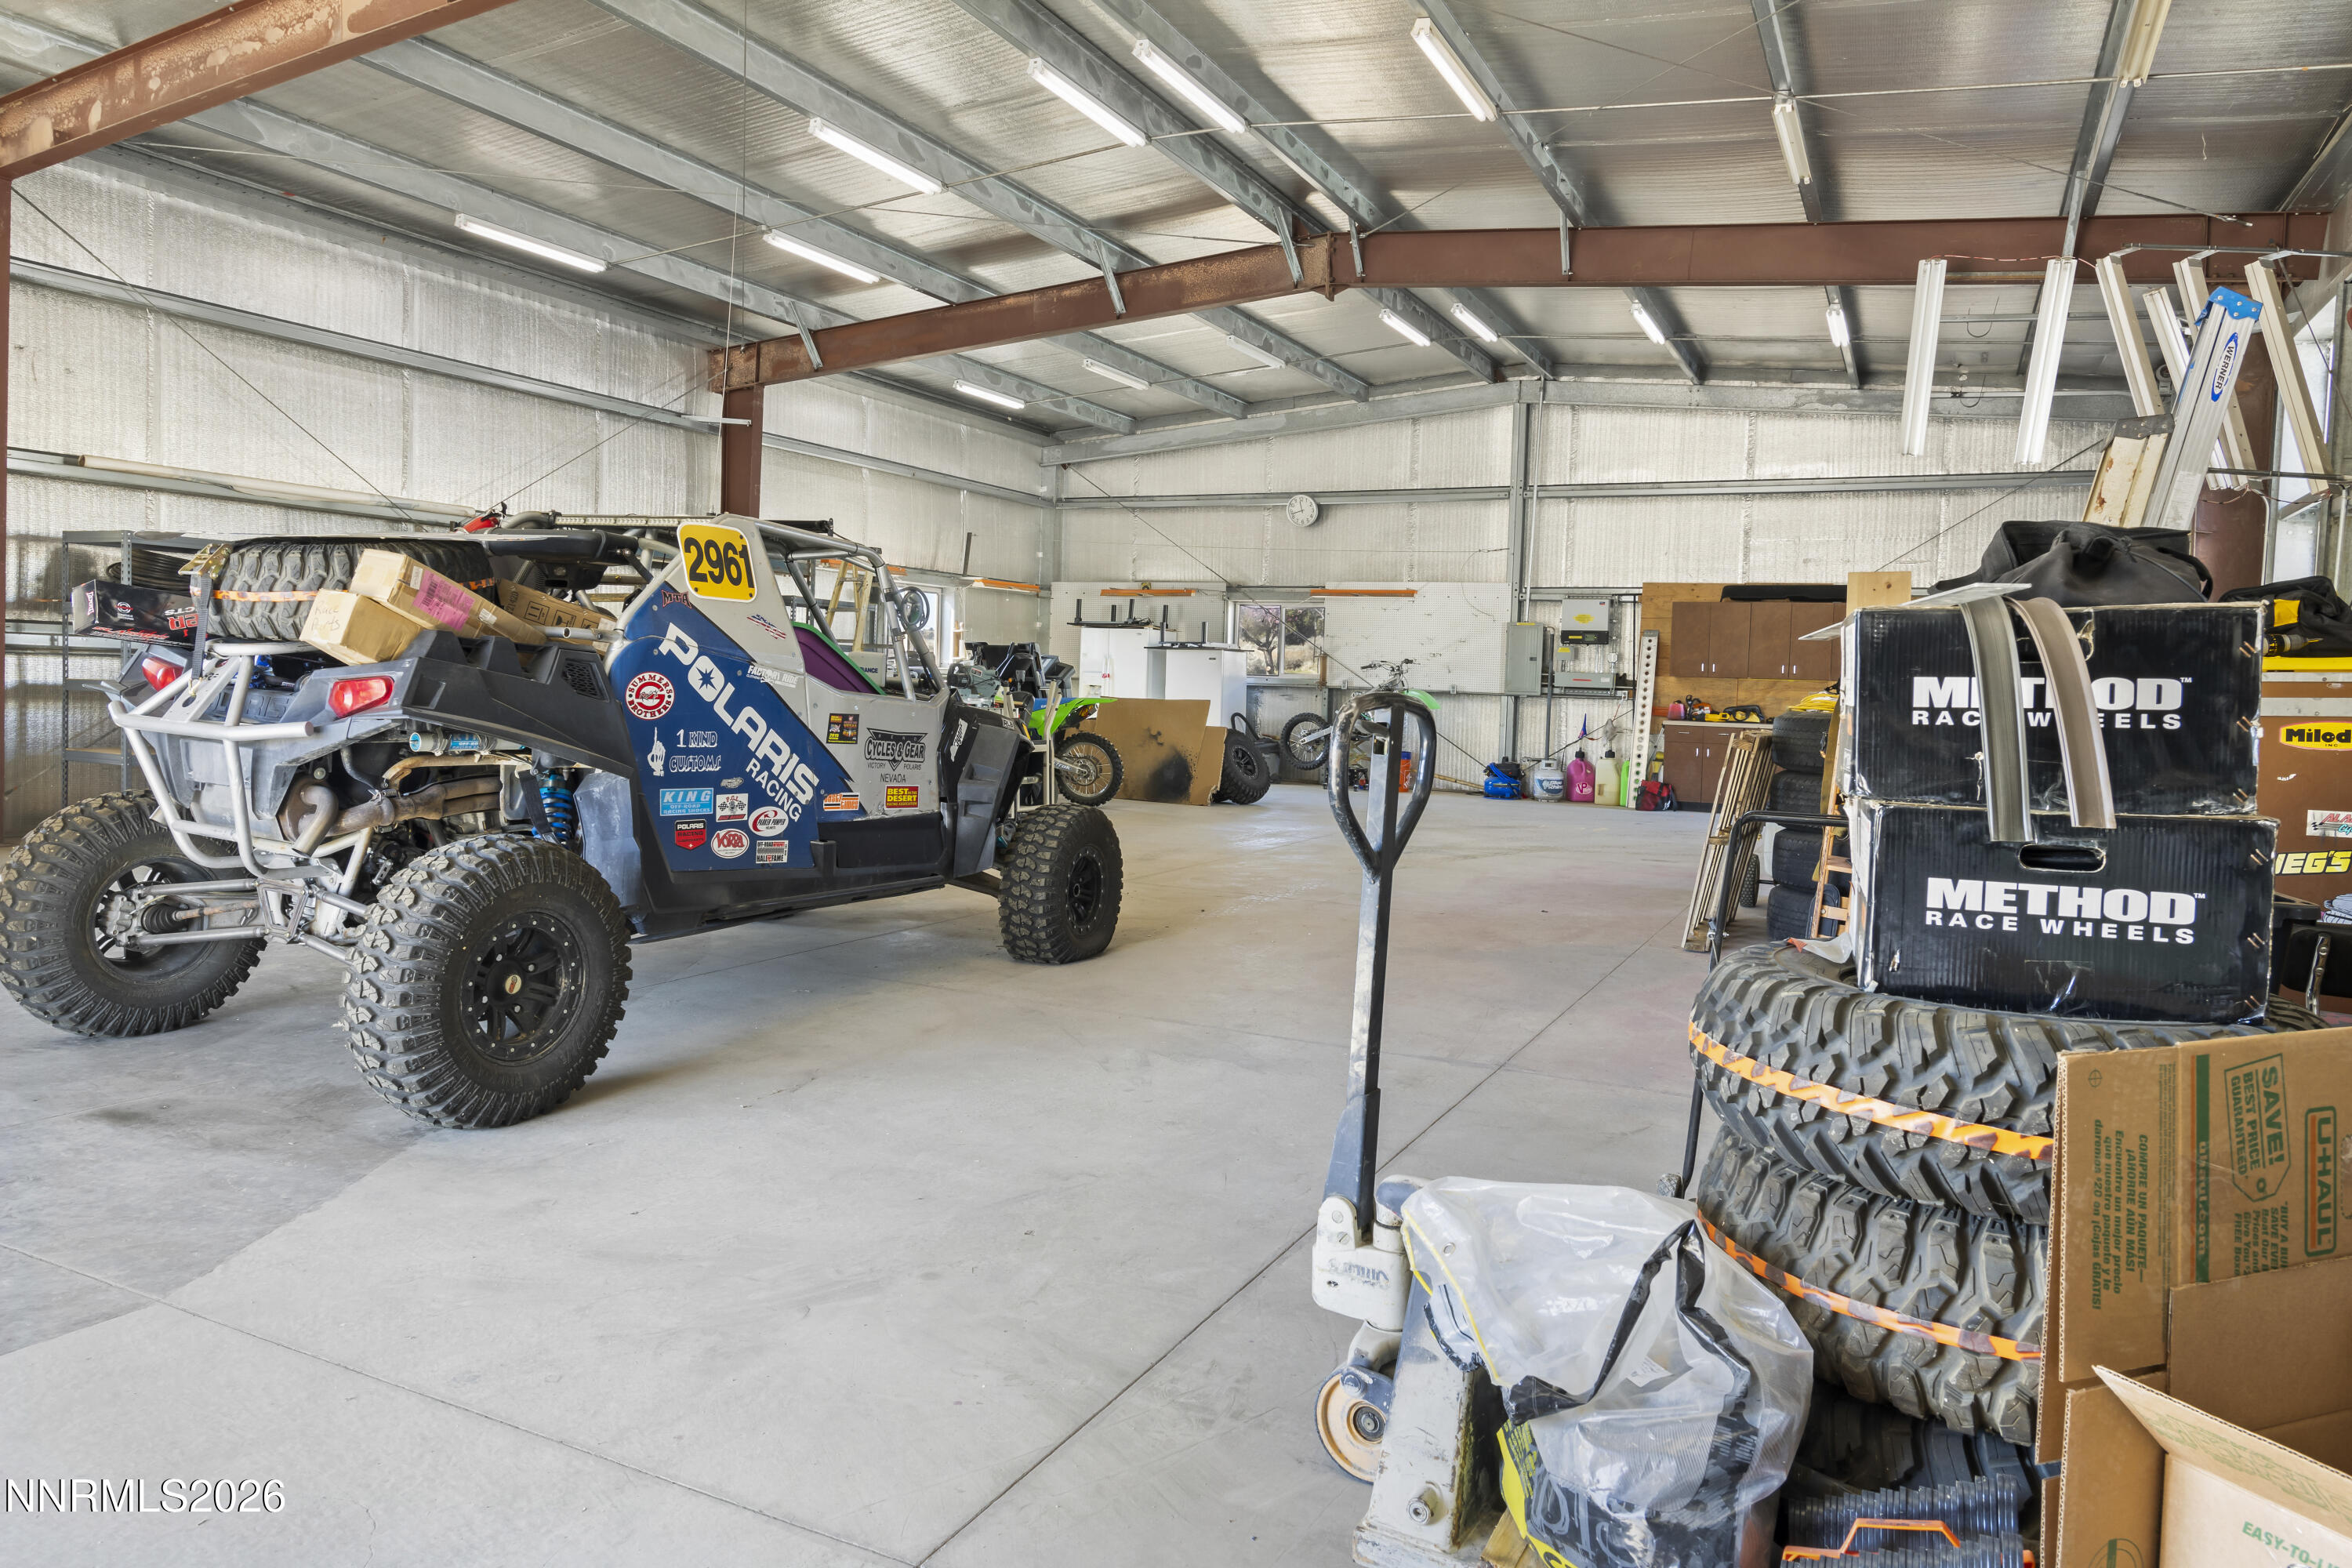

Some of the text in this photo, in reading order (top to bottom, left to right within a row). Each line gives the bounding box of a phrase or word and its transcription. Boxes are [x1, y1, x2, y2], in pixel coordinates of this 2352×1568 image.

[2215, 345, 2235, 390] WERNER
[684, 537, 755, 589] 2961
[628, 674, 673, 694] SUMMERS
[1912, 677, 2183, 710] MTOD
[628, 699, 672, 717] BROTHERS
[658, 622, 820, 805] POLARIS
[1912, 710, 2182, 730] RAC WELS
[676, 728, 718, 748] 1 KIND
[867, 738, 924, 759] CYCLES & GEAR
[2285, 728, 2351, 743] Milod
[669, 755, 722, 773] CUSTOMS
[880, 773, 906, 783] NEVADA
[663, 790, 712, 803] KING
[746, 757, 802, 822] RACING
[1926, 877, 2195, 925] METHOD
[1926, 910, 2194, 945] RACE WHEELS
[2242, 1071, 2261, 1171] BEST PRICE
[2262, 1065, 2285, 1167] SAVE!
[2103, 1136, 2112, 1160] que
[2115, 1130, 2125, 1193] Encuentre
[2138, 1134, 2149, 1189] COMPRE
[2103, 1163, 2113, 1211] nuestro
[2317, 1116, 2332, 1246] U-HAUL
[2092, 1201, 2100, 1216] en
[2114, 1196, 2122, 1212] un
[2138, 1191, 2147, 1210] UN
[2125, 1208, 2137, 1236] AÚN
[2234, 1213, 2242, 1243] FREE
[2252, 1210, 2261, 1247] Prices
[2270, 1207, 2279, 1240] SAVE
[2102, 1214, 2112, 1265] paquete
[2243, 1241, 2252, 1263] You
[2261, 1239, 2270, 1261] Our
[2280, 1234, 2288, 1243] A
[2103, 1278, 2112, 1291] le
